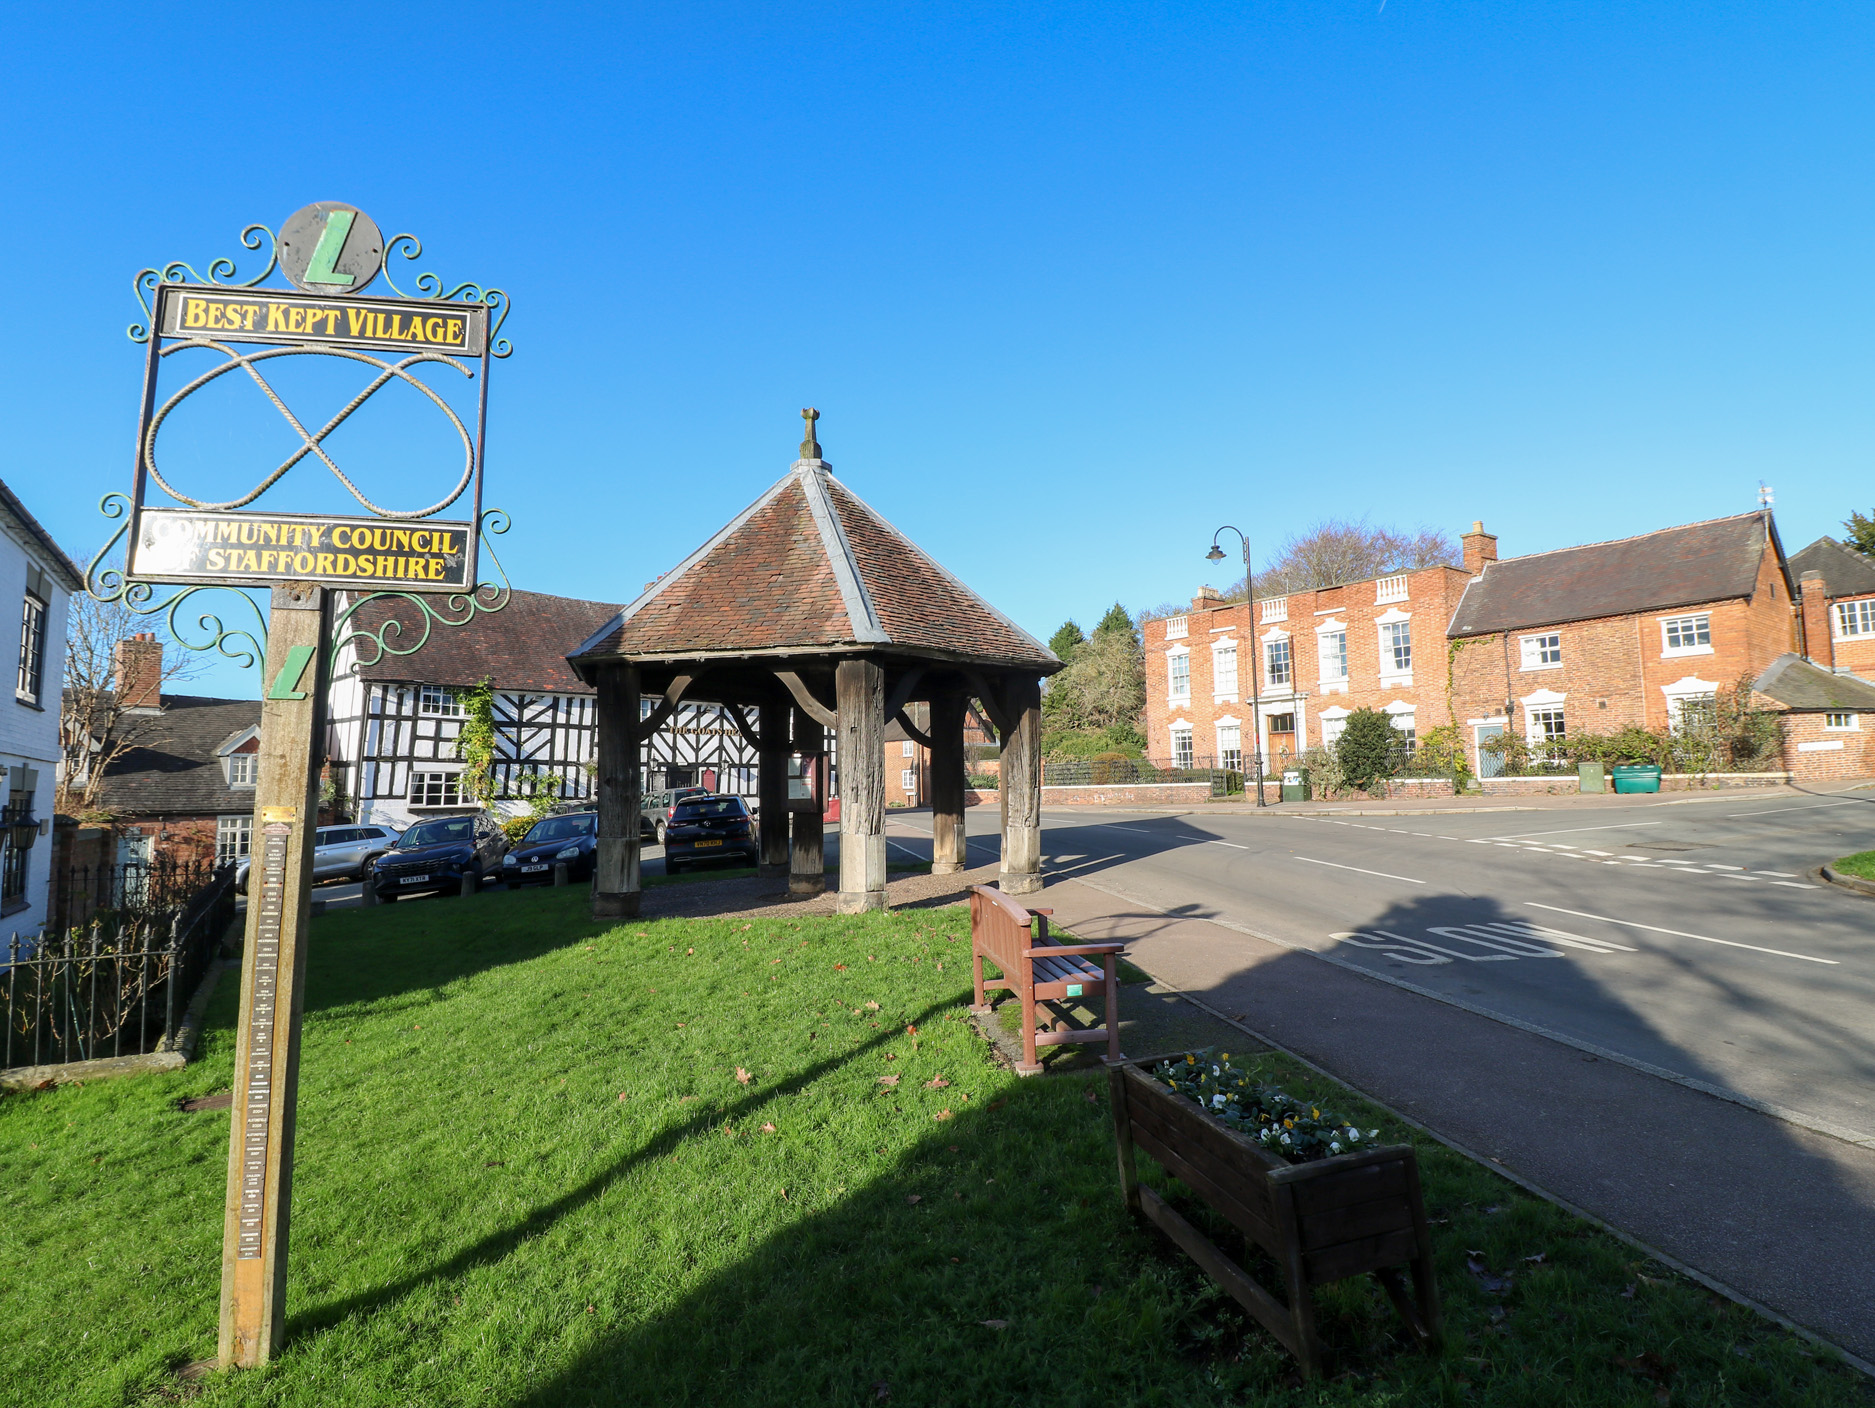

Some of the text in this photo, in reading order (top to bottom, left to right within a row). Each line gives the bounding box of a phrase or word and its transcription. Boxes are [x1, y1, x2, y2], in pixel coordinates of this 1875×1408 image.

[185, 299, 463, 344] BEST KEPT VILLAGE
[331, 526, 458, 554] COUNCIL
[206, 548, 446, 580] STAFFORDSHIRE
[669, 726, 687, 735] THE
[725, 729, 743, 737] HEA
[1328, 921, 1639, 965] SLOW
